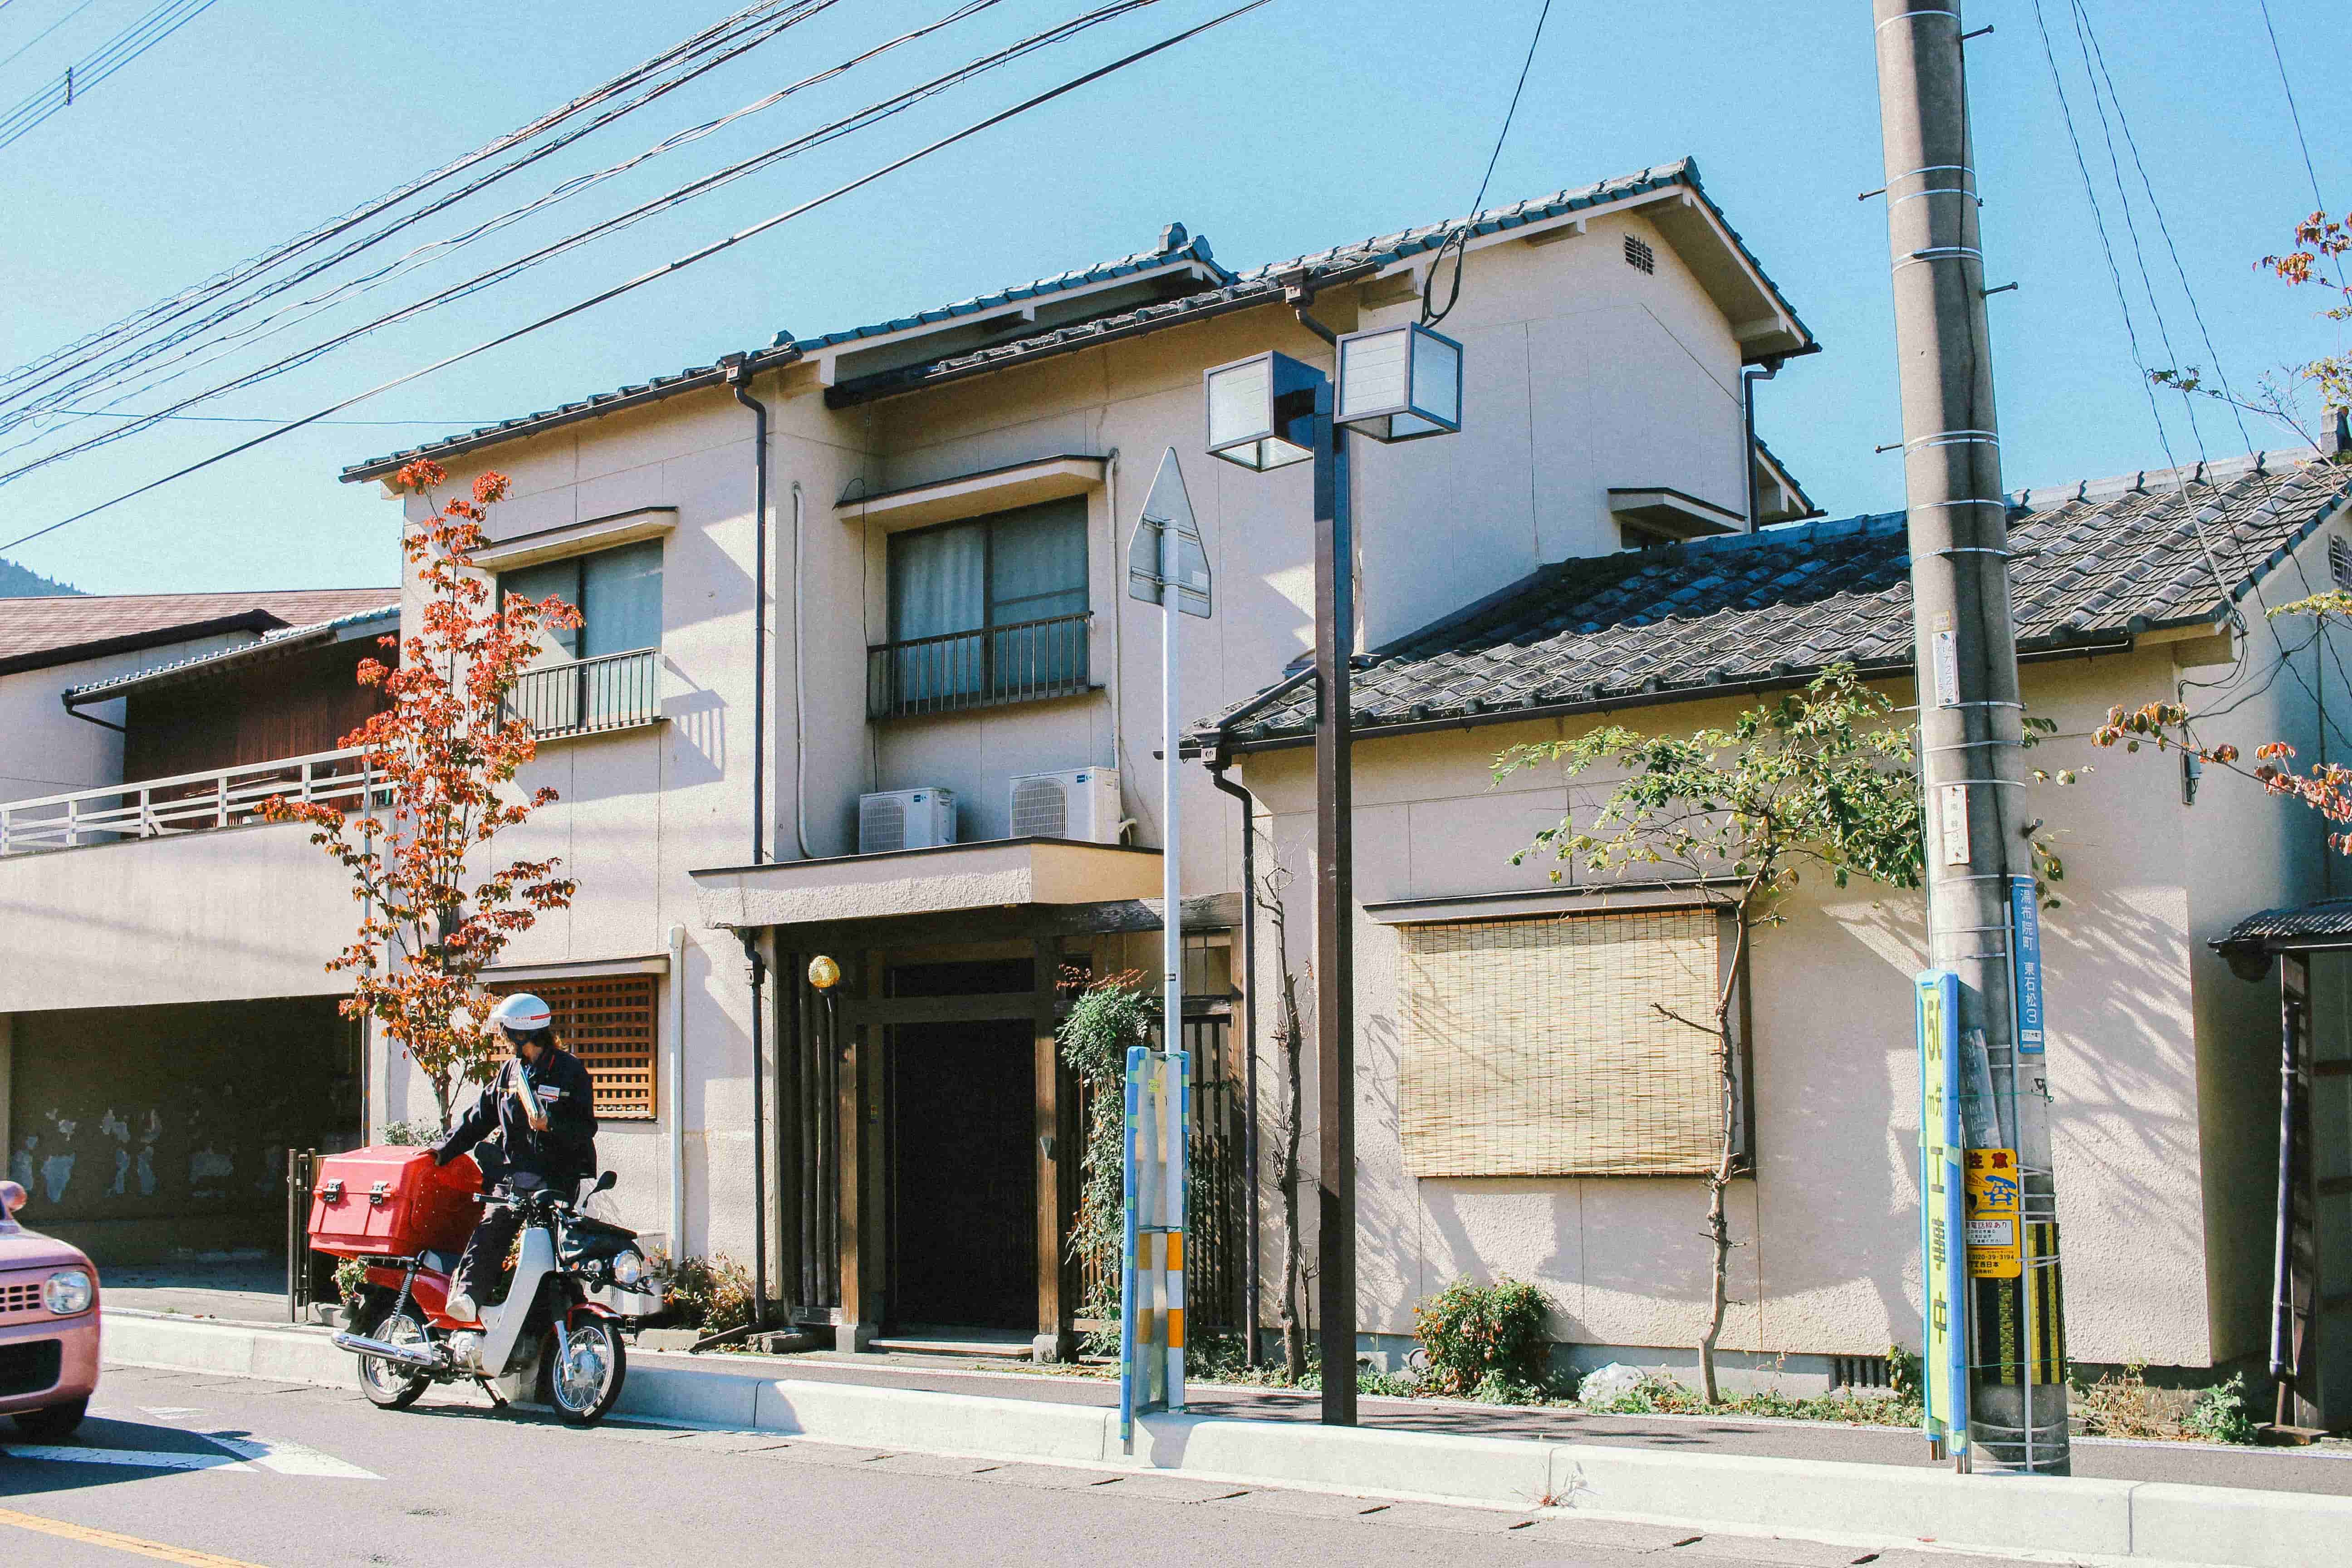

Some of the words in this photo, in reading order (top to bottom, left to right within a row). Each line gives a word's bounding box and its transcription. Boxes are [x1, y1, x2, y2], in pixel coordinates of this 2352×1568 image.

[2020, 889, 2034, 951] 湯布院町
[2023, 961, 2037, 1024] 東石松3
